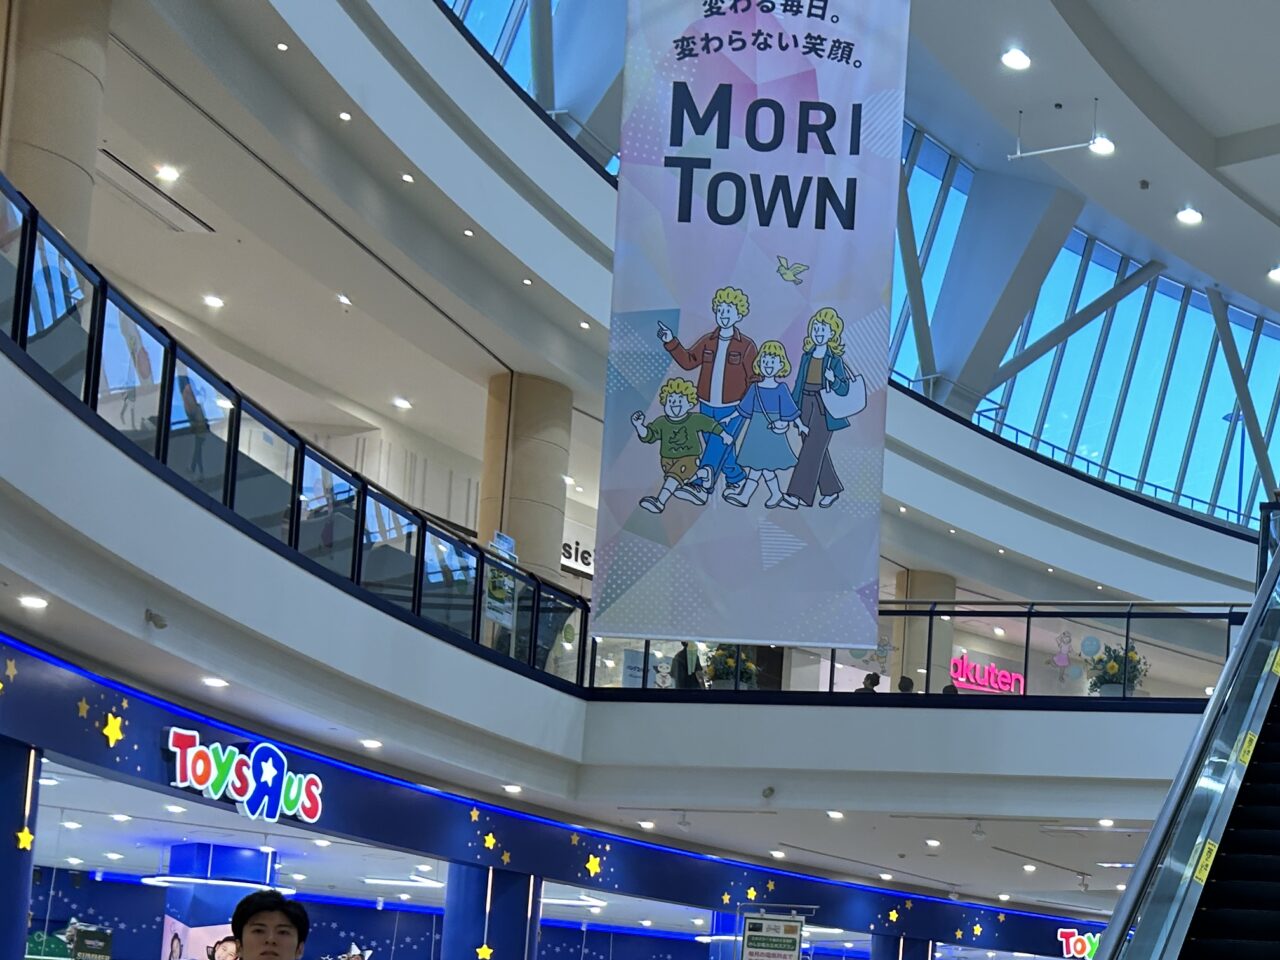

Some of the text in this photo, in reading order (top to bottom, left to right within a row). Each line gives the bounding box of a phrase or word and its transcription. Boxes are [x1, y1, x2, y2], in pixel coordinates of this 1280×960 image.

[702, 0, 840, 24] 変わる毎日。
[673, 29, 863, 69] 変わらない笑顔。
[669, 80, 863, 156] MORI
[664, 156, 857, 231] TOWN
